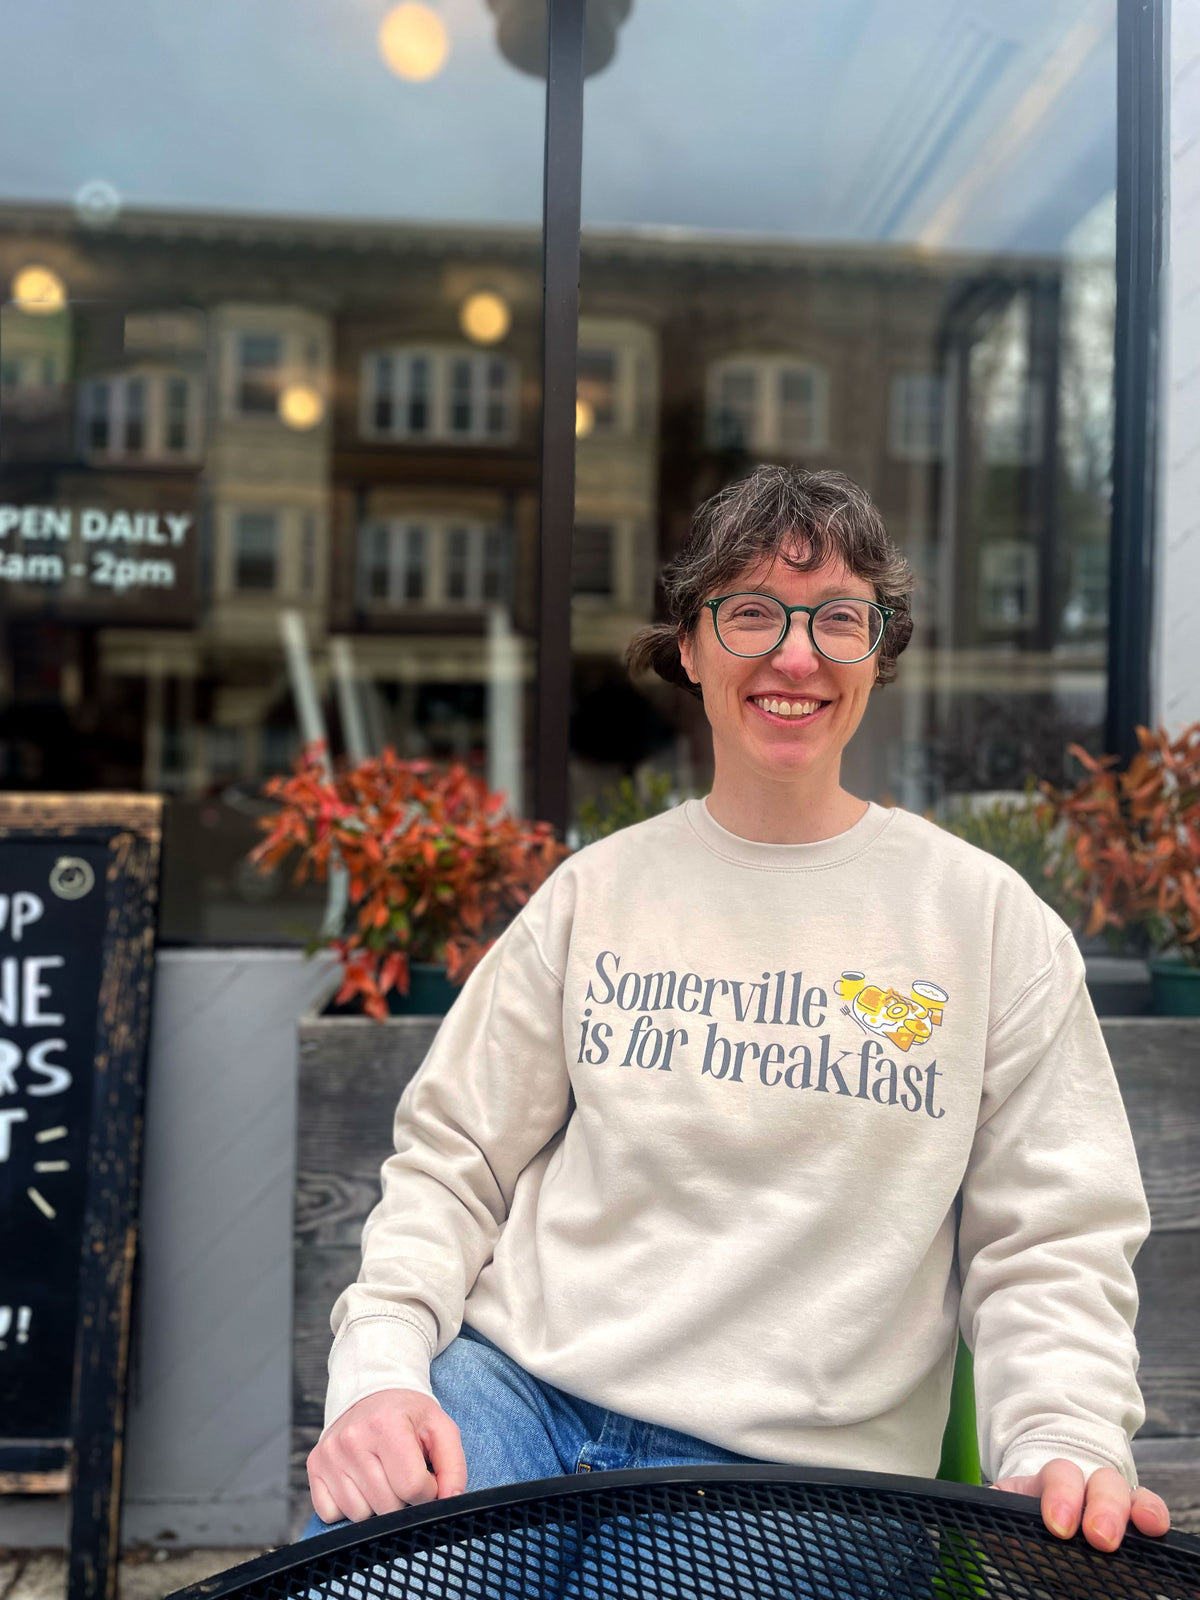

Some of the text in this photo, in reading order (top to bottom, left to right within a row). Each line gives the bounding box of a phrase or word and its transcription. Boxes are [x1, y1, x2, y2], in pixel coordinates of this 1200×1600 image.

[80, 508, 192, 547] DAILY
[0, 549, 64, 582] am
[91, 551, 176, 595] 2pm
[584, 950, 828, 1028] Somerville
[576, 1008, 946, 1119] is for breakfast
